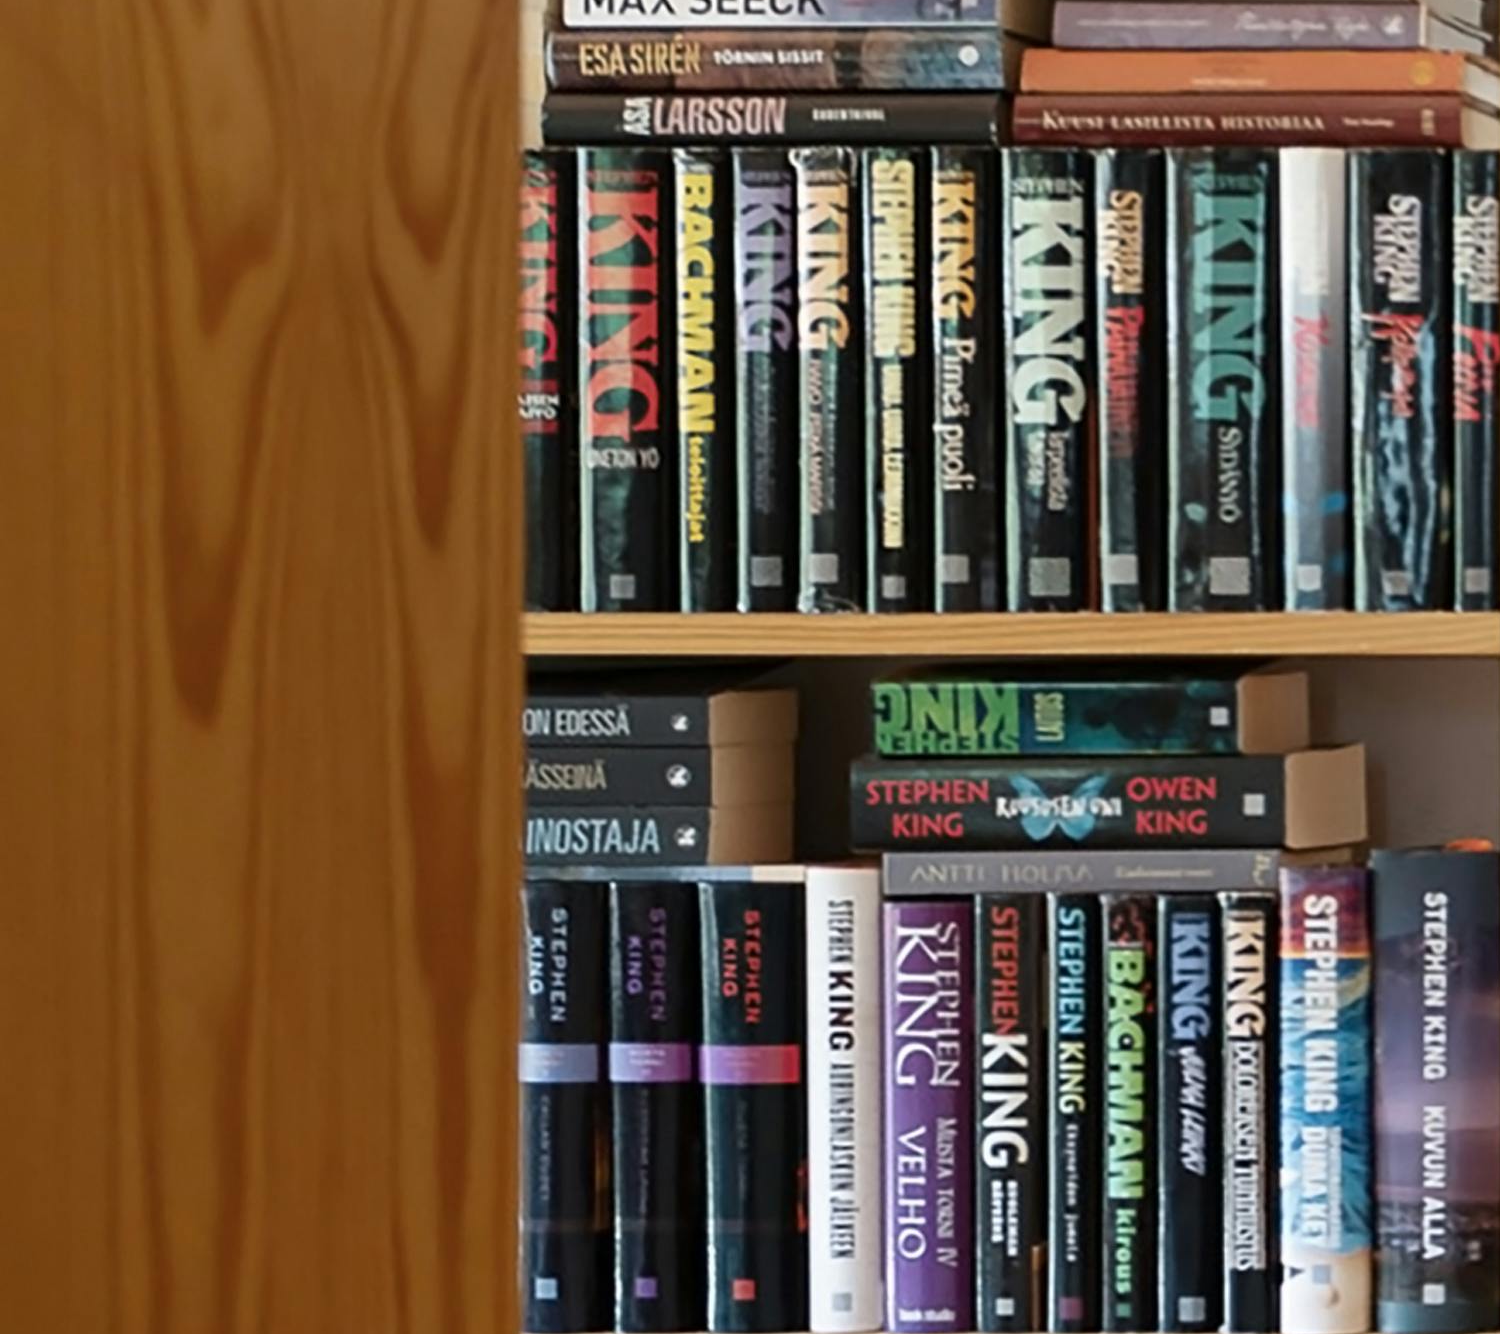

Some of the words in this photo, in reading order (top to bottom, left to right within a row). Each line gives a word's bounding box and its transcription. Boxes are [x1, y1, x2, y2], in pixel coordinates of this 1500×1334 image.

[579, 43, 627, 76] ESA
[628, 34, 701, 75] SIRÉN
[653, 97, 786, 136] LARSSON
[739, 185, 793, 353] KING
[799, 185, 851, 352] KING
[933, 184, 976, 320] KING
[1111, 190, 1144, 295] STEPHEN
[1373, 213, 1402, 286] KING
[1387, 194, 1421, 304] STEPHEN
[1467, 194, 1500, 304] STEPHEN
[586, 186, 660, 444] KING
[679, 171, 716, 434] BACHMAN
[1013, 194, 1086, 425] KING
[1192, 189, 1267, 424] KING
[943, 336, 976, 418] Pimeä
[932, 423, 973, 492] puoli
[556, 702, 630, 737] EDESSÄ
[874, 681, 1019, 733] KING
[525, 817, 660, 855] INOSTAJA
[865, 780, 989, 806] STEPHEN
[891, 813, 964, 838] KING
[1127, 776, 1217, 801] OWEN
[1135, 811, 1208, 837] KING
[527, 934, 545, 997] KING
[550, 907, 569, 1023] STEPHEN
[626, 934, 643, 996] KING
[649, 907, 667, 1022] STEPHEN
[722, 937, 739, 998] KING
[744, 909, 762, 1025] STEPHEN
[827, 899, 855, 964] STEPHEN
[990, 906, 1020, 1037] STEPHEN
[1058, 907, 1086, 1036] STEPHEN
[1170, 922, 1210, 1041] KING
[1225, 918, 1266, 1038] KING
[1303, 893, 1339, 1030] STEPHEN
[1422, 891, 1448, 1008] STEPHEN
[828, 969, 855, 1052] KING
[895, 921, 940, 1087] KING
[934, 921, 961, 1088] STEPHEN
[1422, 1014, 1447, 1082] KING
[829, 1062, 855, 1192] AURINGONLASKUN
[981, 1031, 1029, 1169] KING
[1058, 1040, 1086, 1115] KING
[1107, 947, 1146, 1201] BACHMAN
[1305, 1038, 1339, 1113] KING
[897, 1125, 927, 1260] VELHO
[1422, 1105, 1446, 1190] KUVUN
[1114, 1207, 1136, 1295] kirous
[1421, 1196, 1446, 1261] ALLA
